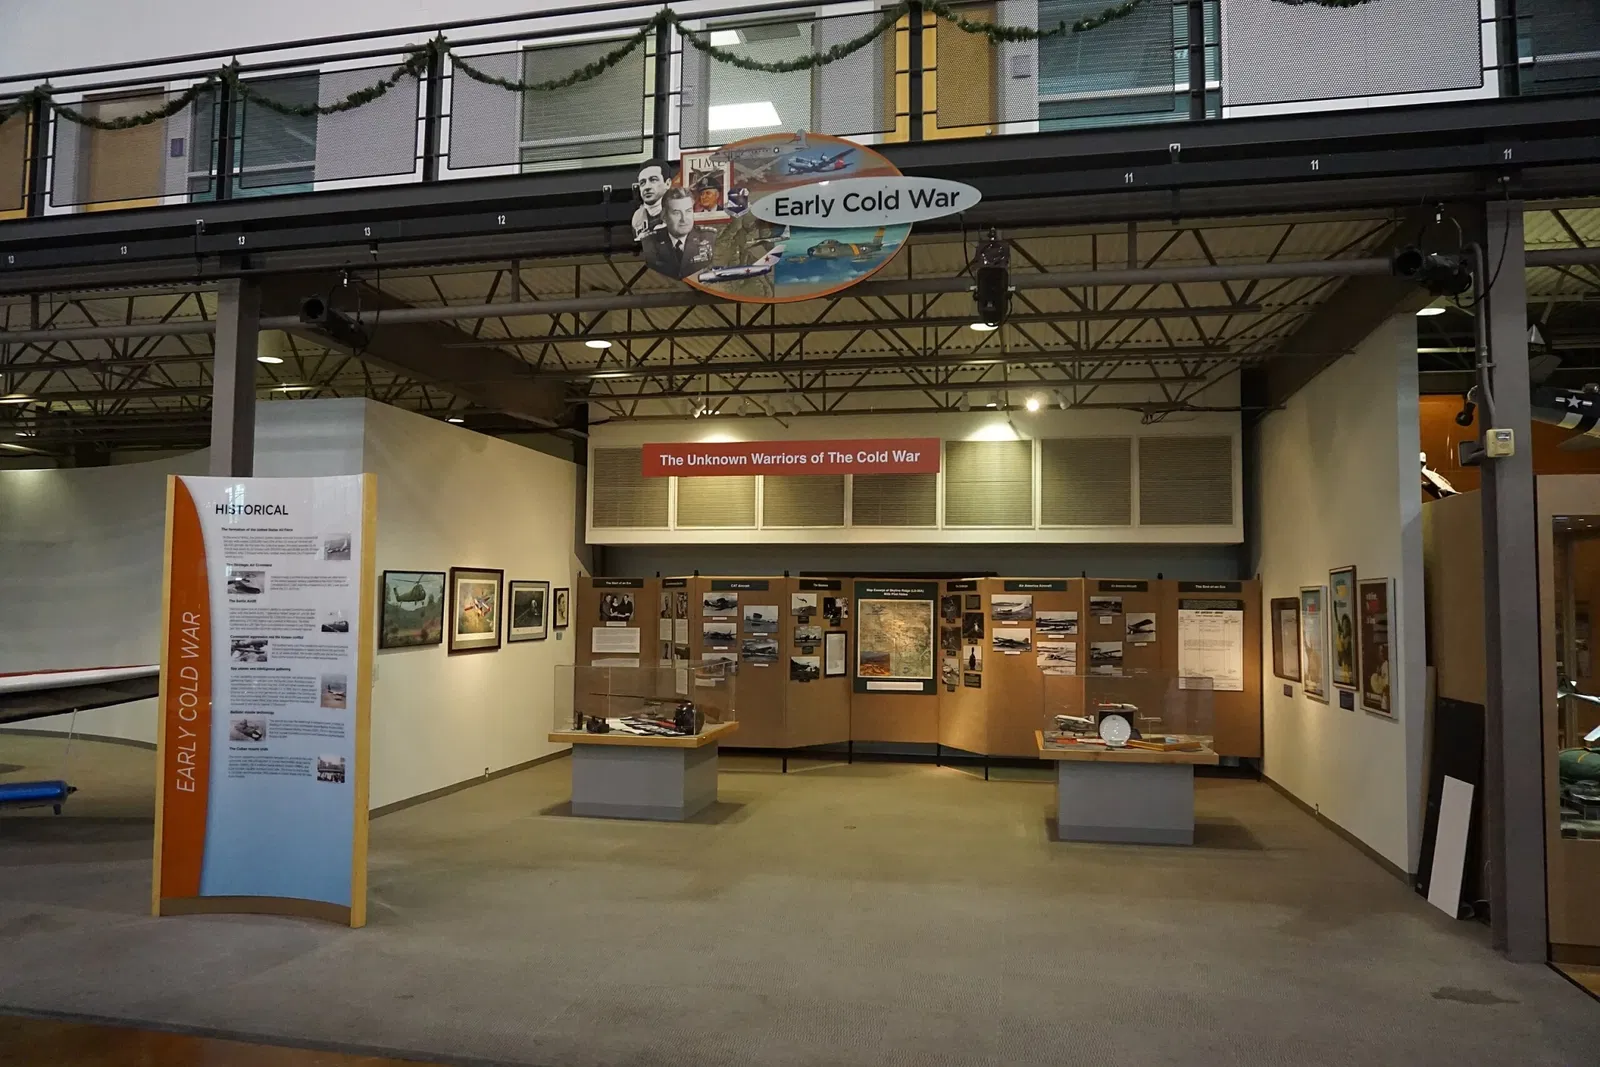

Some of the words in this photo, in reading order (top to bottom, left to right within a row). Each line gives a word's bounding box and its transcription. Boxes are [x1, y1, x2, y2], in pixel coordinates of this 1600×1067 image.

[1504, 148, 1512, 160] 11
[1311, 159, 1319, 170] 11
[1124, 172, 1134, 183] 11
[775, 194, 835, 218] Early
[843, 190, 899, 212] Cold
[908, 188, 960, 209] War
[497, 215, 506, 225] 12
[364, 227, 371, 236] 13
[238, 236, 245, 245] 13
[120, 246, 128, 255] 13
[660, 454, 684, 466] The
[687, 453, 747, 466] Unknown
[751, 452, 807, 465] Warriors
[811, 451, 825, 464] of
[828, 451, 853, 464] The
[856, 450, 888, 463] Cold
[892, 450, 921, 462] War
[215, 504, 289, 516] HISTORICAL
[180, 611, 201, 659] WAR
[178, 666, 199, 722] COLD
[176, 725, 197, 793] EARLY
